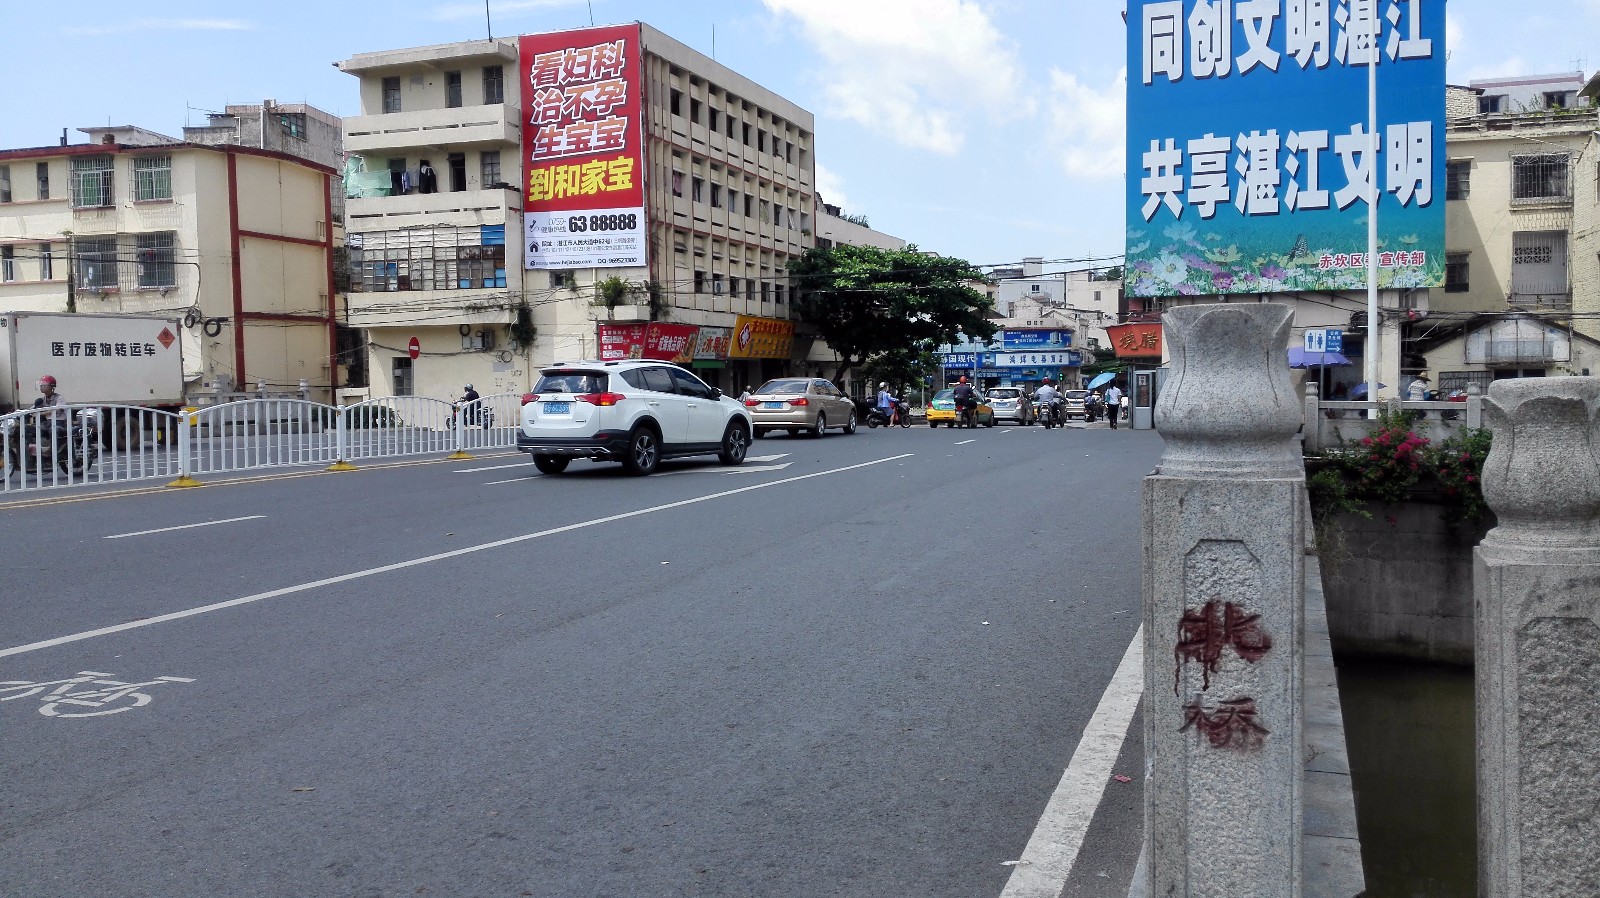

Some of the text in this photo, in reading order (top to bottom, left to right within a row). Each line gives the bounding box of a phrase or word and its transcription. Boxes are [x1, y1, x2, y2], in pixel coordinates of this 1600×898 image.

[530, 39, 627, 89] 看妇科
[1142, 0, 1432, 84] 同创文明湛江
[530, 78, 628, 125] 治不孕
[531, 115, 628, 162] 生宝宝
[529, 155, 634, 202] 到和家宝
[1140, 120, 1433, 222] 共享湛江文明
[568, 213, 637, 233] 63 88888
[51, 342, 156, 357] 医疗废物转运车
